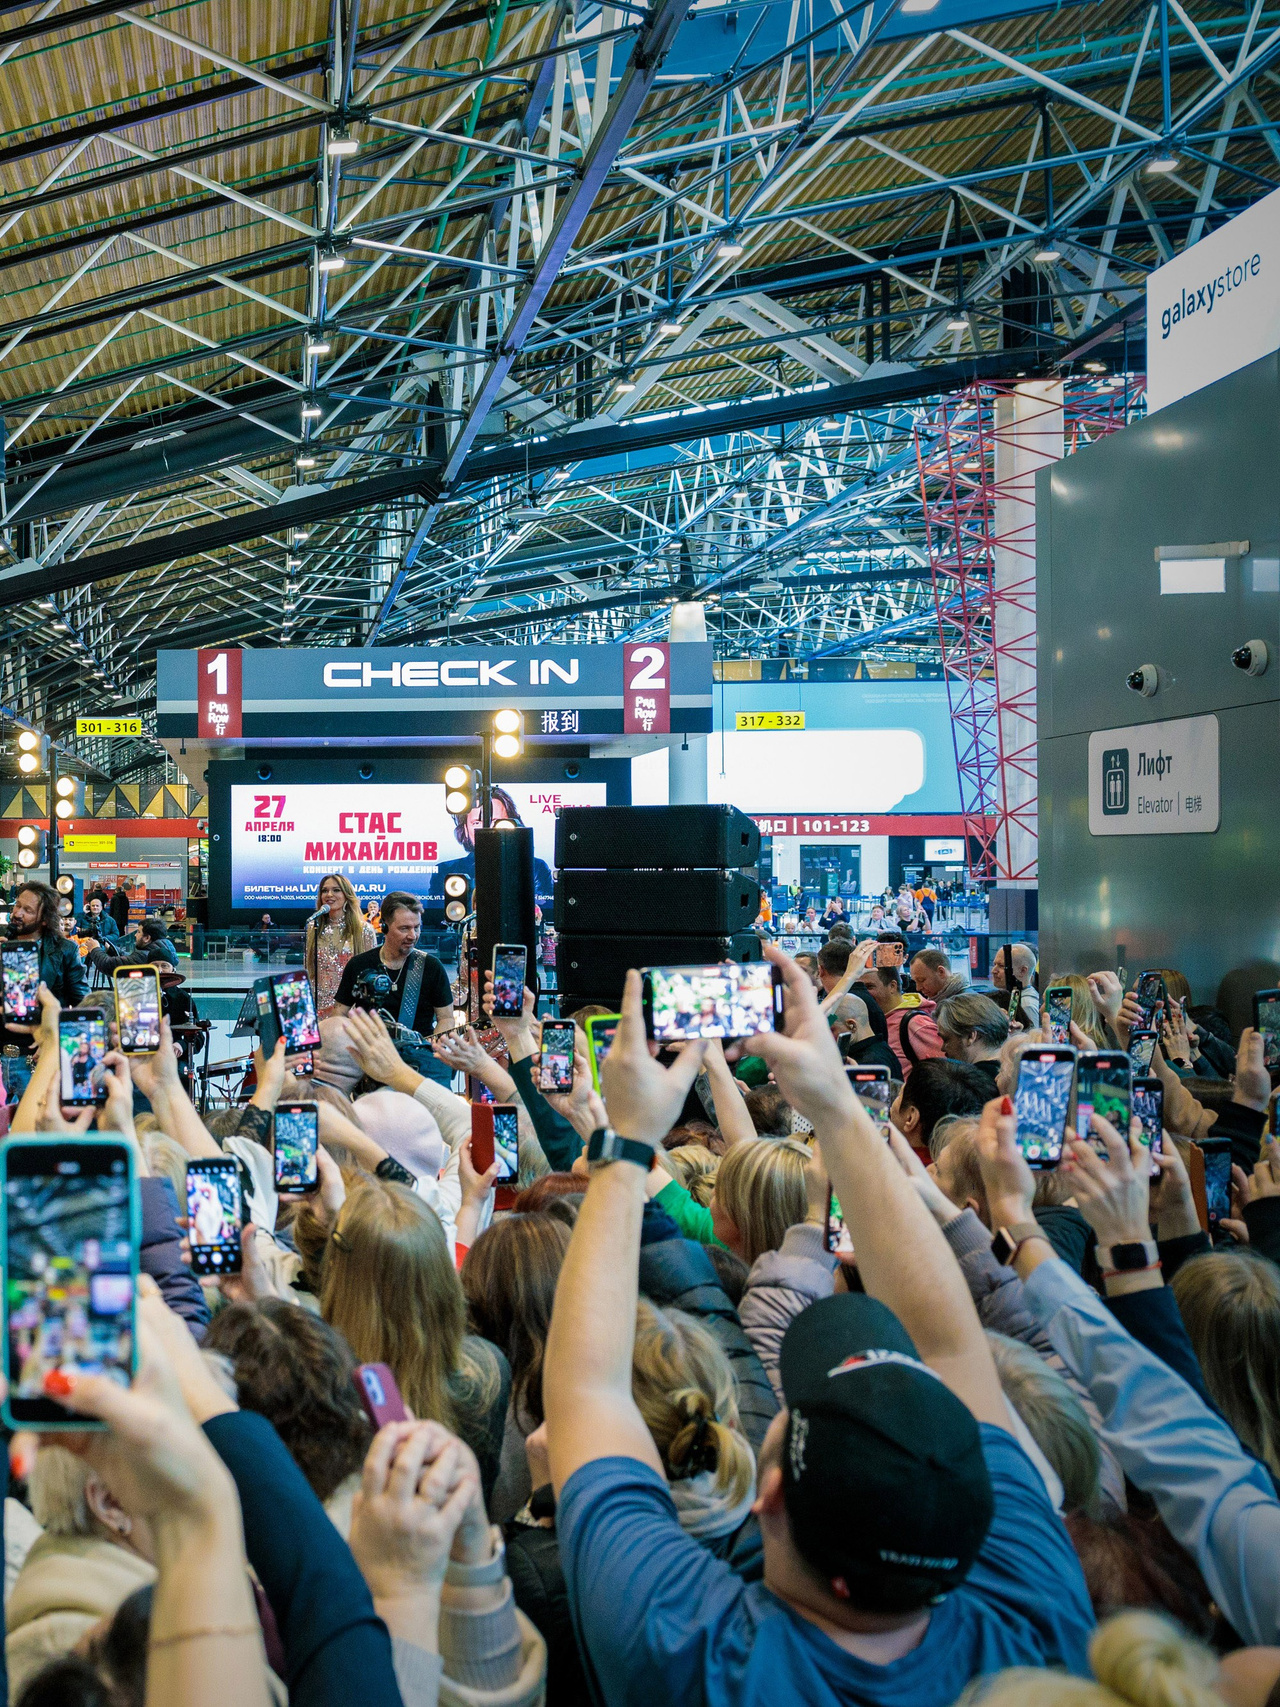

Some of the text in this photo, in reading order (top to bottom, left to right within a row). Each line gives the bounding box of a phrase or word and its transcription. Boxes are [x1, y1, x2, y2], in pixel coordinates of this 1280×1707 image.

[1161, 253, 1261, 340] galaxystore
[207, 653, 228, 695] 1
[323, 658, 579, 688] CHECK IN
[629, 647, 666, 690] 2
[207, 712, 229, 724] Row
[634, 707, 657, 719] Row
[740, 716, 764, 727] 317
[776, 715, 801, 726] 332
[80, 722, 104, 733] 301
[113, 722, 138, 733] 316
[541, 710, 579, 734] 报到
[1137, 749, 1173, 781] Лифт
[253, 795, 287, 818] 27
[529, 794, 562, 804] LIVE
[1137, 795, 1174, 814] Elevator
[245, 821, 295, 832] АПРЕЛЯ
[338, 812, 402, 834] СТАС
[802, 820, 870, 833] 101-123
[258, 834, 282, 843] 18:00
[304, 836, 438, 861] МИХАЙЛОВ
[303, 865, 439, 874] КОНЦЕРТ В ДЕНЬ РОЖДЕНИЯ
[244, 885, 284, 893] БИЛЕТЫ
[285, 885, 299, 893] НА
